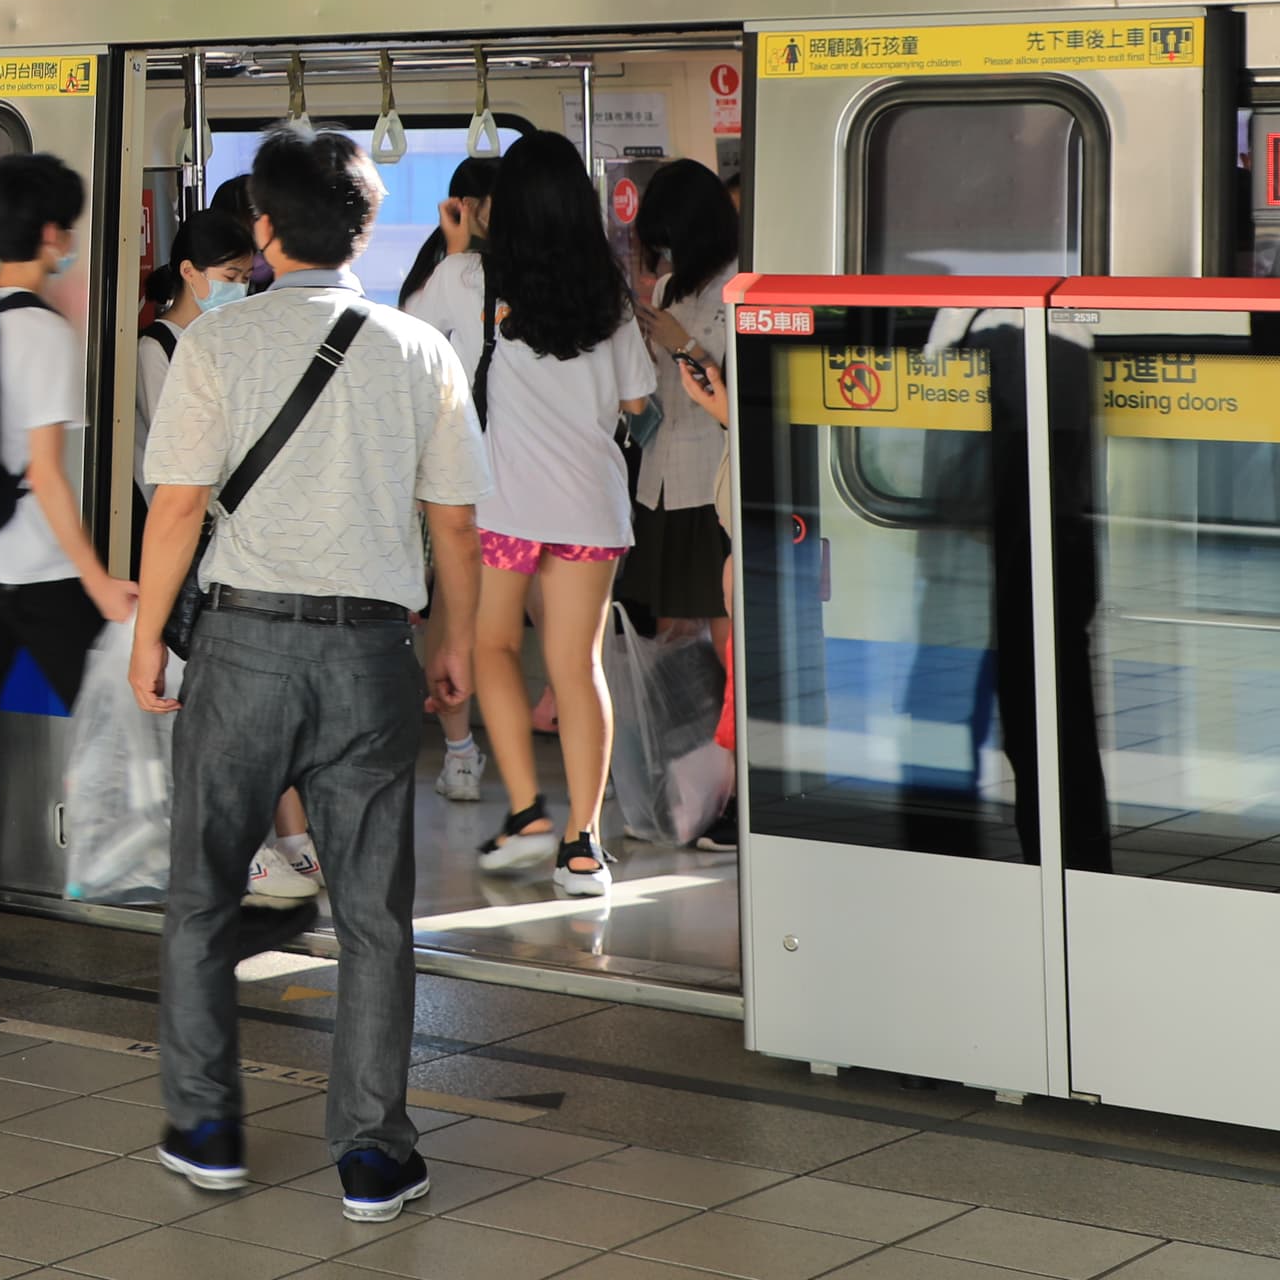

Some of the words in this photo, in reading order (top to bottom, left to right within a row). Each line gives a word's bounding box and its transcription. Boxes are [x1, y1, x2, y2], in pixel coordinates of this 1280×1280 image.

[809, 36, 919, 58] 照顧隨行孩童
[1026, 27, 1145, 51] 先下車後上車
[926, 58, 962, 68] children
[984, 56, 1014, 66] Please
[1015, 55, 1039, 65] allow
[1041, 54, 1095, 65] passengers
[1097, 54, 1106, 63] to
[739, 310, 810, 332] 第5車廂
[908, 383, 970, 403] Please
[1178, 392, 1238, 412] doors
